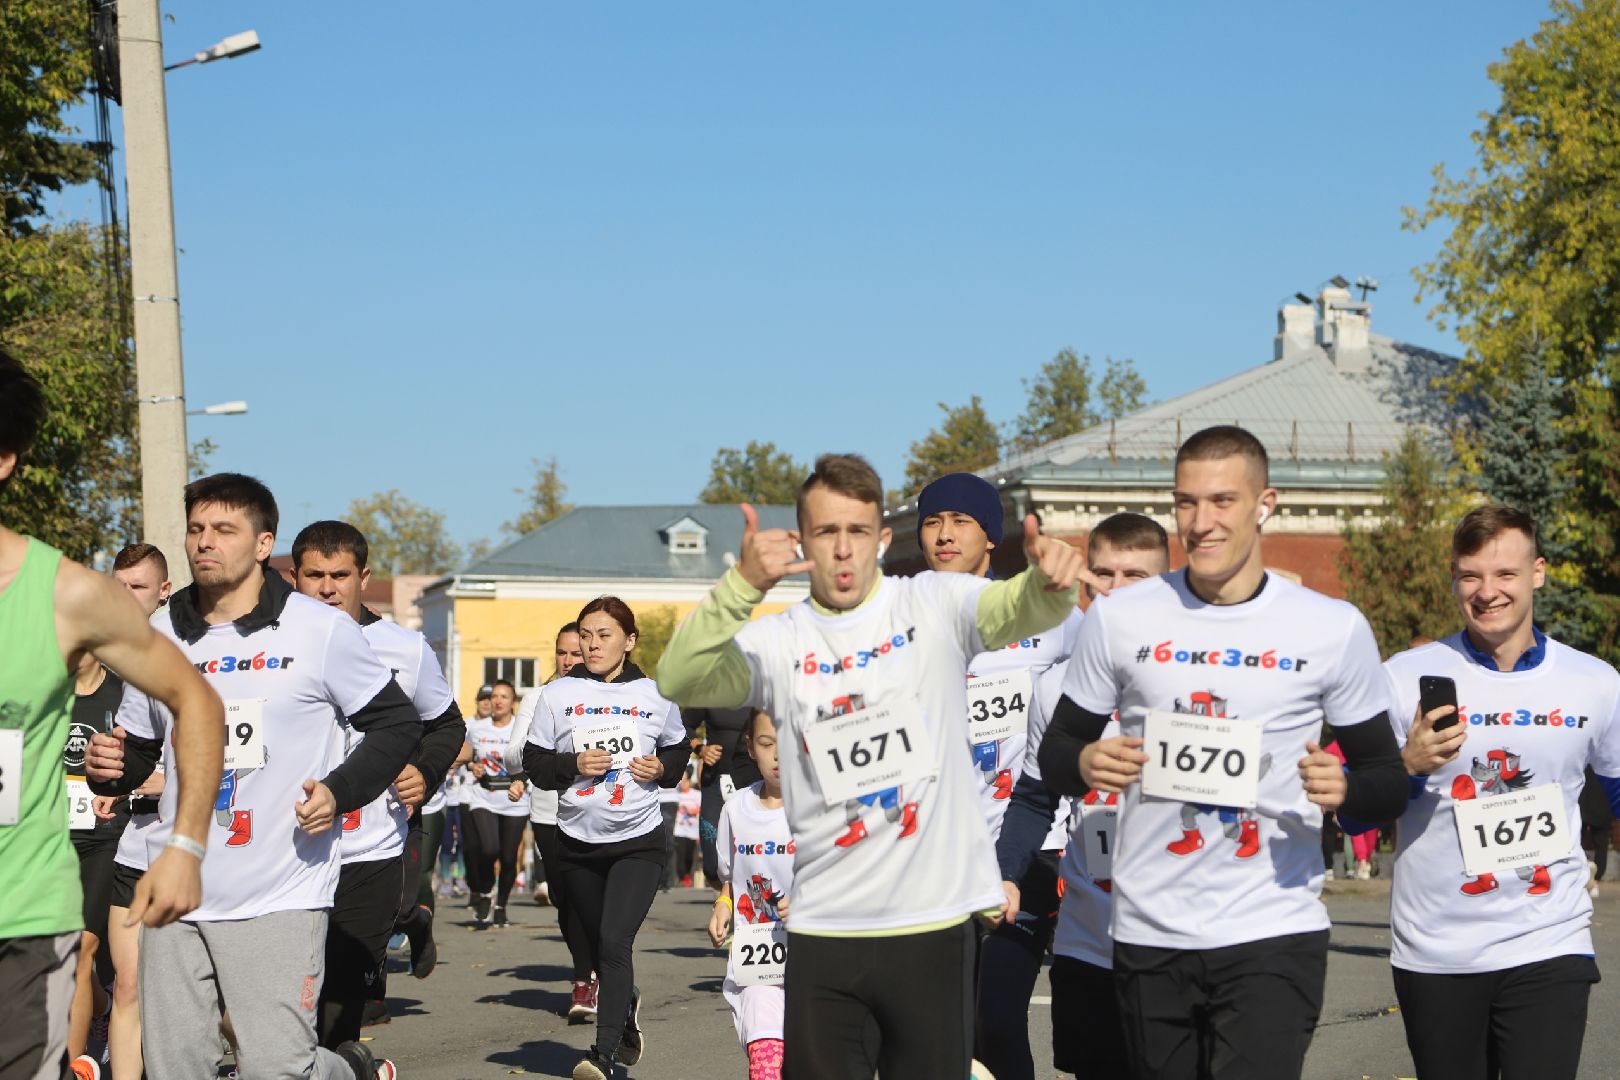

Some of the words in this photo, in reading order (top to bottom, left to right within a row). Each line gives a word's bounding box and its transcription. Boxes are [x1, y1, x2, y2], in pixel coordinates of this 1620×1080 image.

[1136, 640, 1308, 672] #боксЗабег
[565, 704, 653, 719] #боксЗабег
[827, 727, 912, 773] 1671
[1159, 741, 1245, 777] 1670
[1474, 811, 1556, 848] 1673
[740, 942, 787, 966] 220
